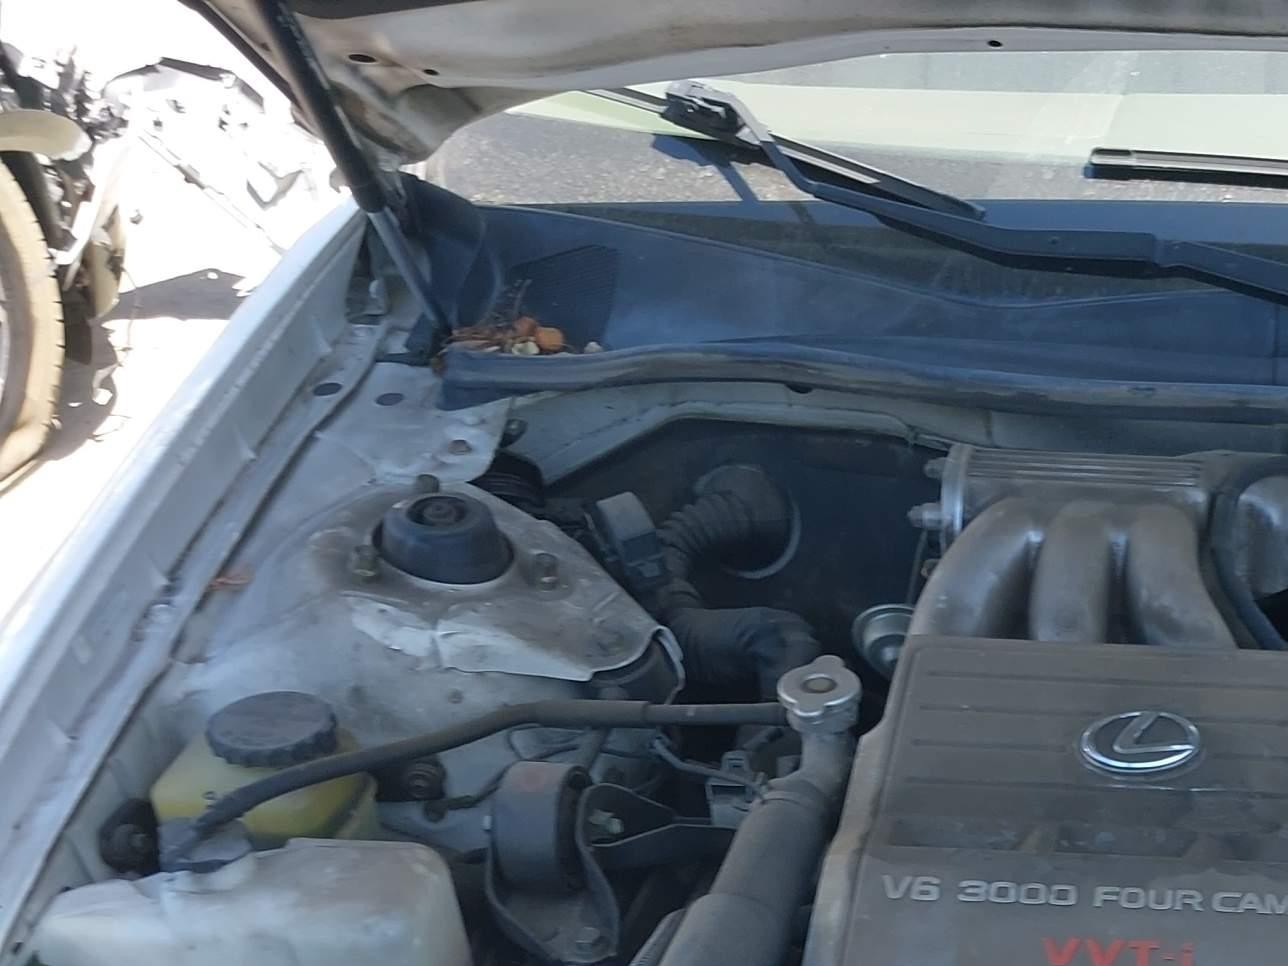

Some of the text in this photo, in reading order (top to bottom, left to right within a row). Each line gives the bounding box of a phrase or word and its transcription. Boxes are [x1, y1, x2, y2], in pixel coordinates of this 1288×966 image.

[881, 873, 941, 902] V6
[956, 879, 1078, 907] 3000
[1093, 885, 1206, 913] FOUR
